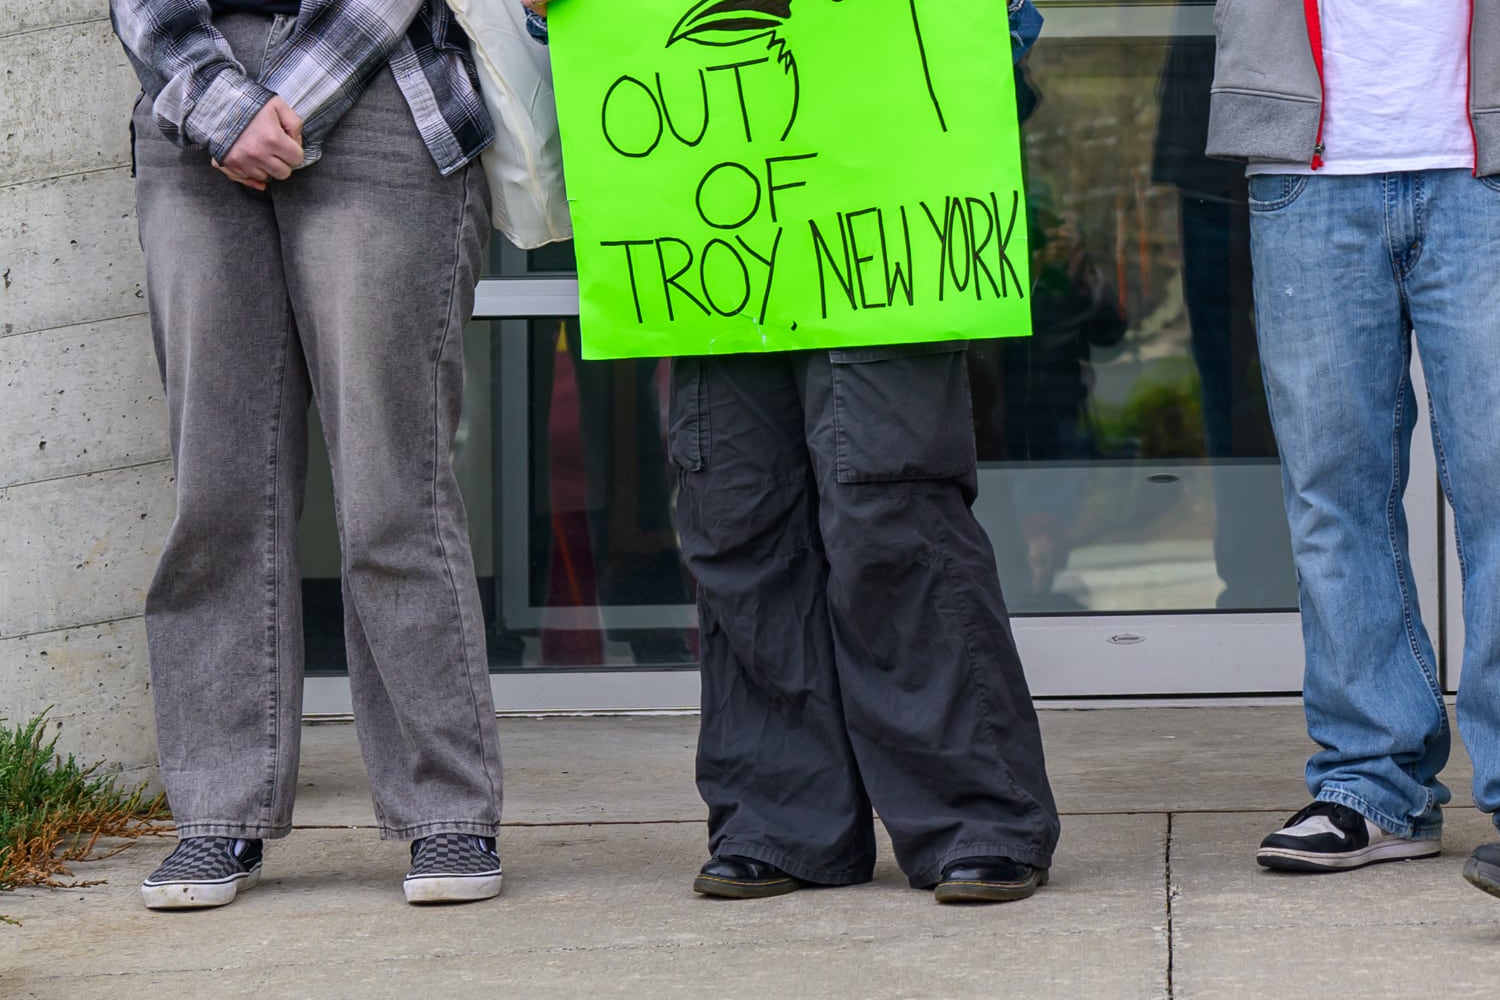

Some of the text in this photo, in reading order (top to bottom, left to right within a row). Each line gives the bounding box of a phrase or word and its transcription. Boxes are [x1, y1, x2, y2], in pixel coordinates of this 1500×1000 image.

[601, 56, 769, 158] OUT
[695, 152, 818, 230] OF
[808, 205, 914, 319] NEW
[919, 188, 1025, 301] YORK
